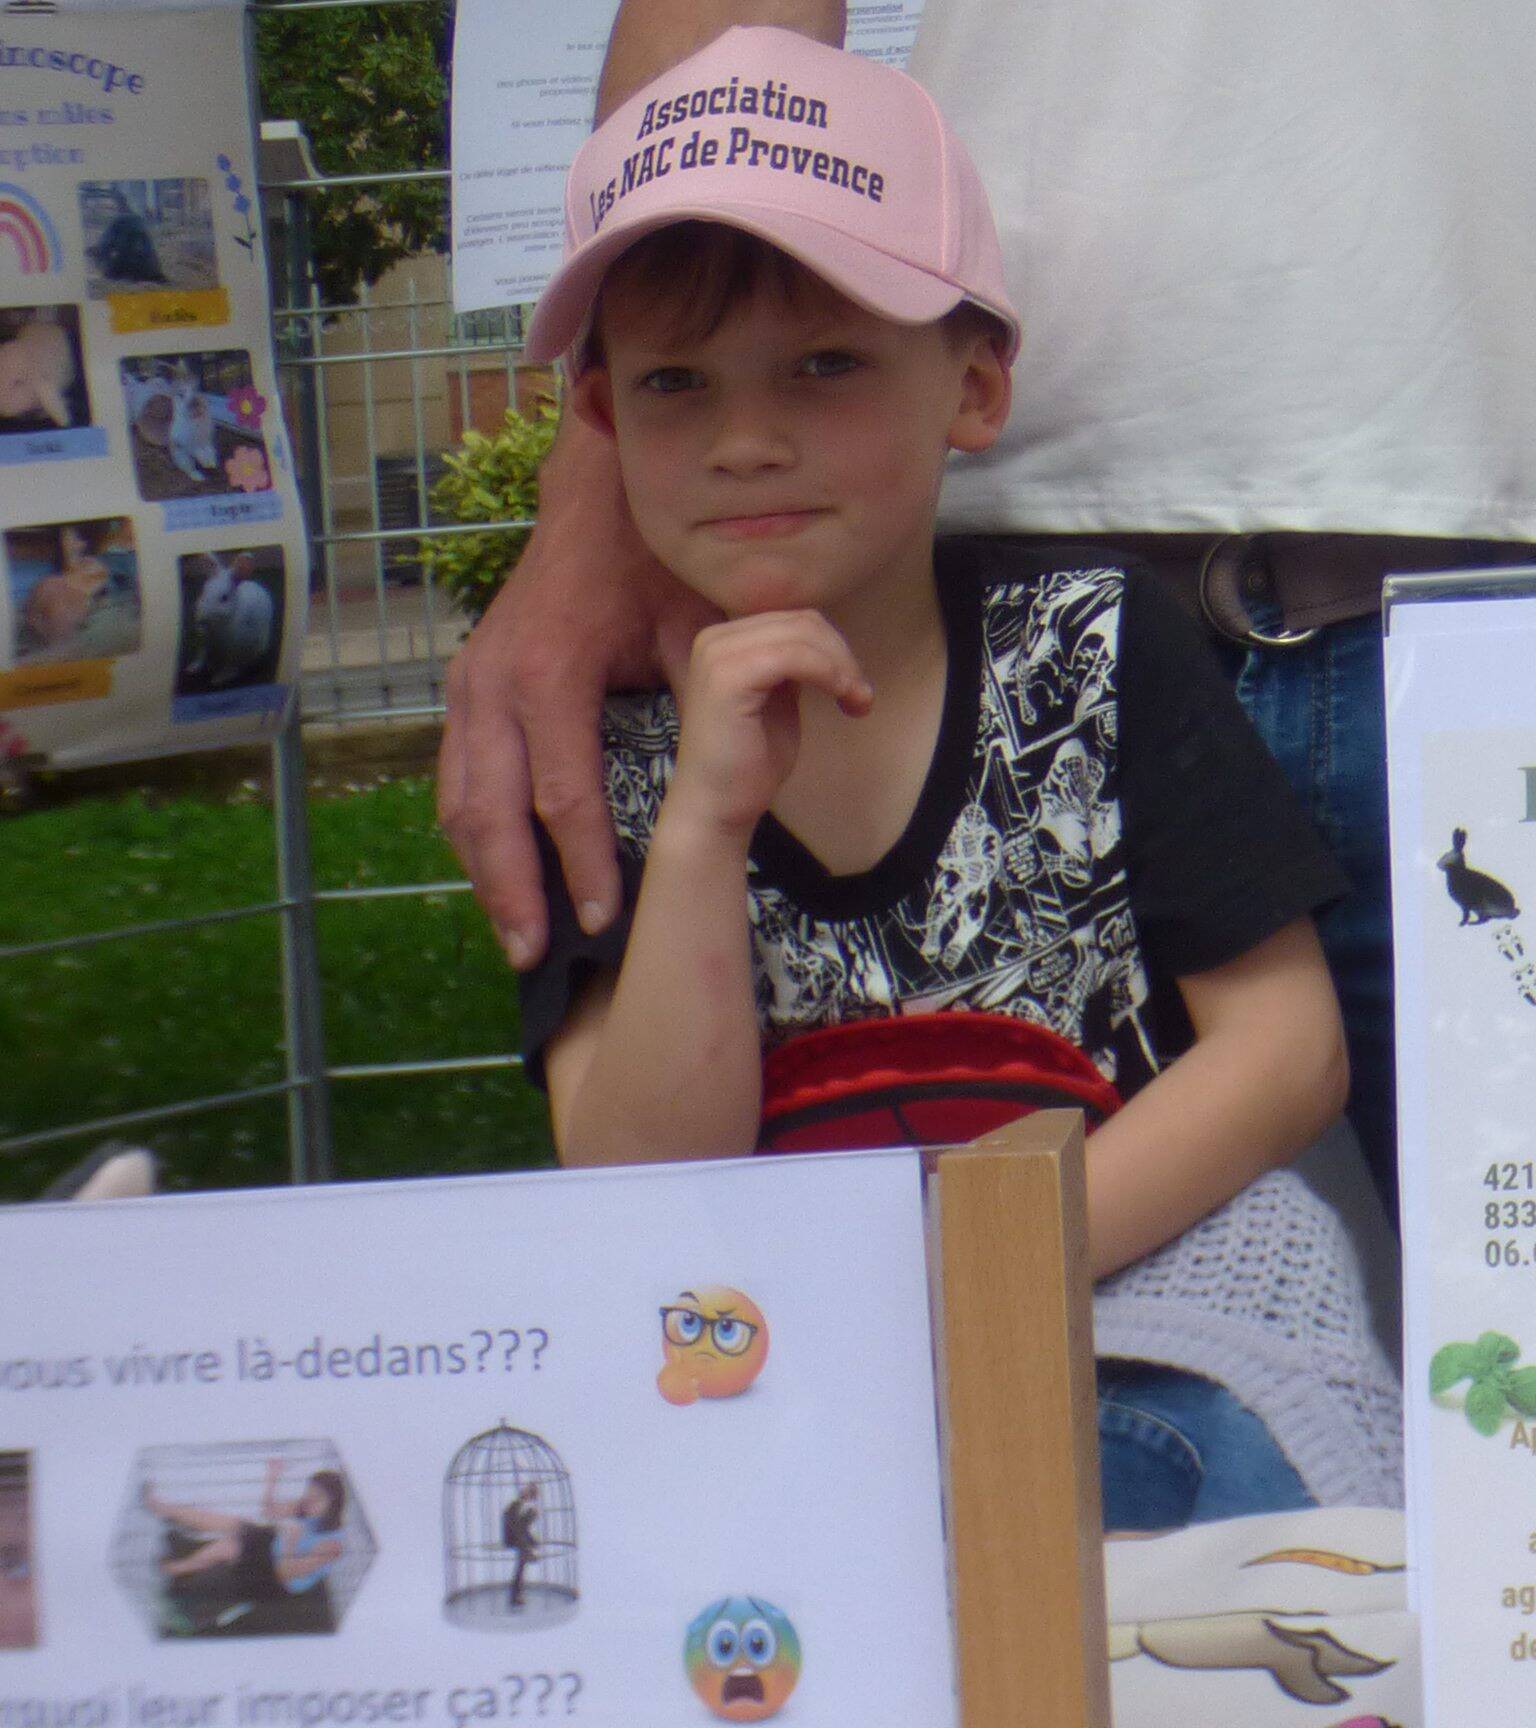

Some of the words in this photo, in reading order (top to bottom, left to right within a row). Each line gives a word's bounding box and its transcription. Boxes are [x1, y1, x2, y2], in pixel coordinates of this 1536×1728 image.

[636, 76, 828, 141] Association
[589, 179, 616, 235] Les
[619, 137, 676, 200] NAC
[680, 130, 719, 170] de
[725, 126, 884, 204] Provence
[1483, 1161, 1534, 1192] 421
[103, 1342, 223, 1387] vivre
[236, 1327, 550, 1382] là-dedans???
[236, 1679, 430, 1728] imposer
[445, 1672, 585, 1728] ça???
